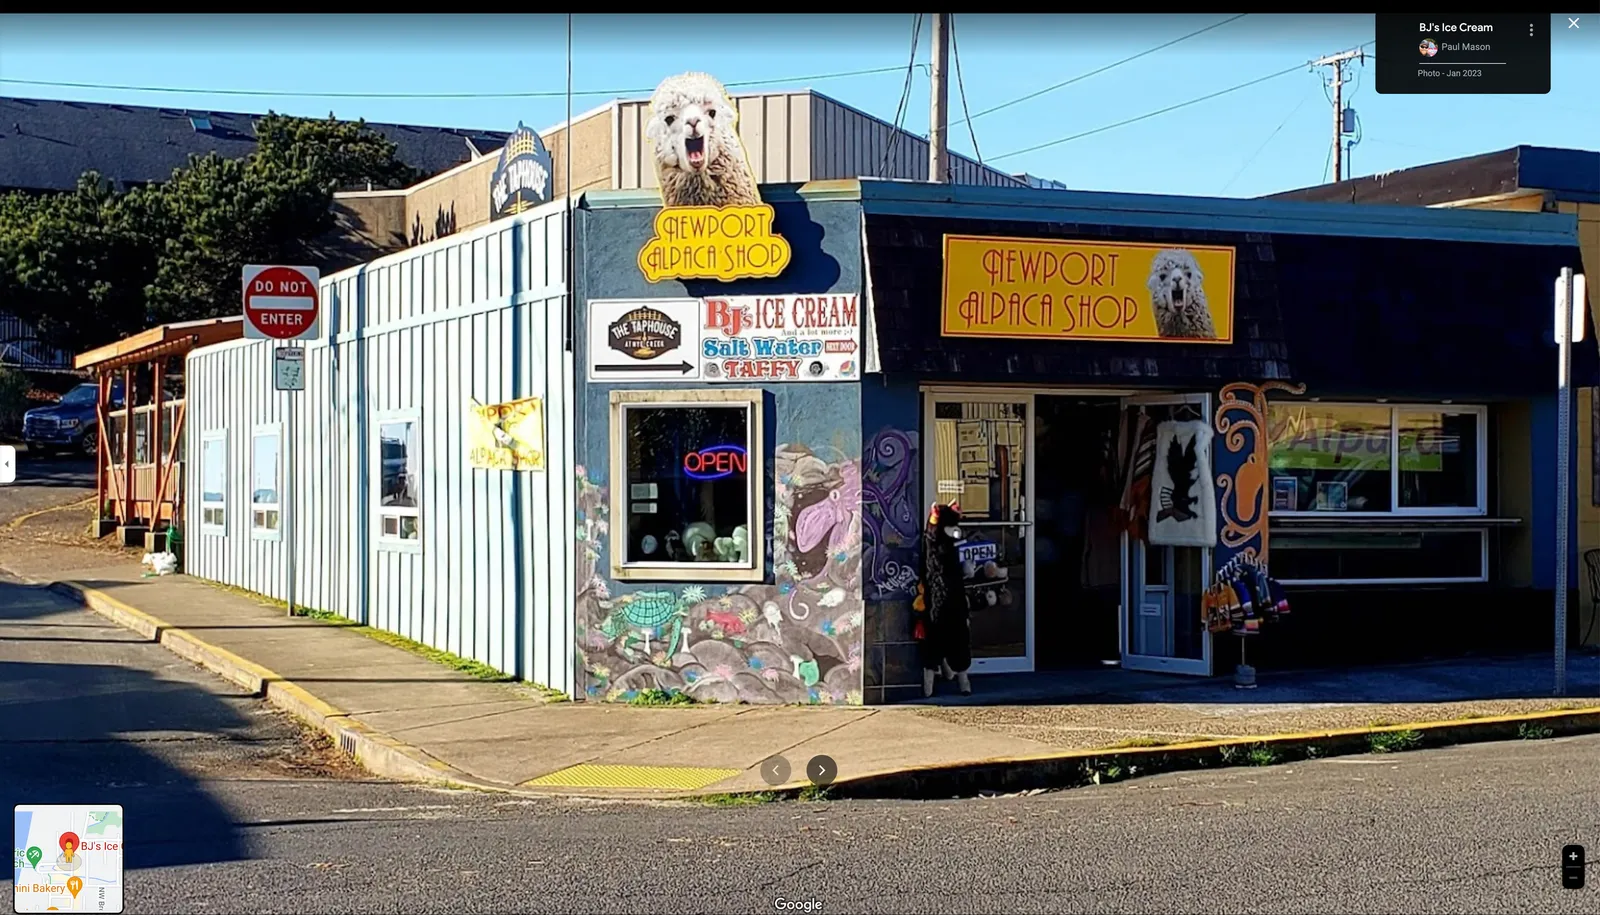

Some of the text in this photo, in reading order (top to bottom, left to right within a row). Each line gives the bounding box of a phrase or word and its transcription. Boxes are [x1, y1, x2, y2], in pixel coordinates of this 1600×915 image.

[663, 212, 767, 242] NEWPORT
[646, 242, 783, 273] ALPACA SHOP
[982, 248, 1120, 287] NEWPORT
[255, 280, 308, 294] DO NOT
[260, 313, 303, 326] ENTER
[704, 295, 858, 337] BJ's ICE CREAM
[958, 291, 1139, 333] ALPACA SHOP
[611, 320, 679, 340] THE TAPHOUSE
[781, 328, 798, 336] And
[807, 328, 818, 336] lot
[703, 338, 823, 357] Salt Water
[724, 359, 801, 379] TAFFY
[684, 451, 747, 473] OPEN
[963, 545, 994, 561] OPEN
